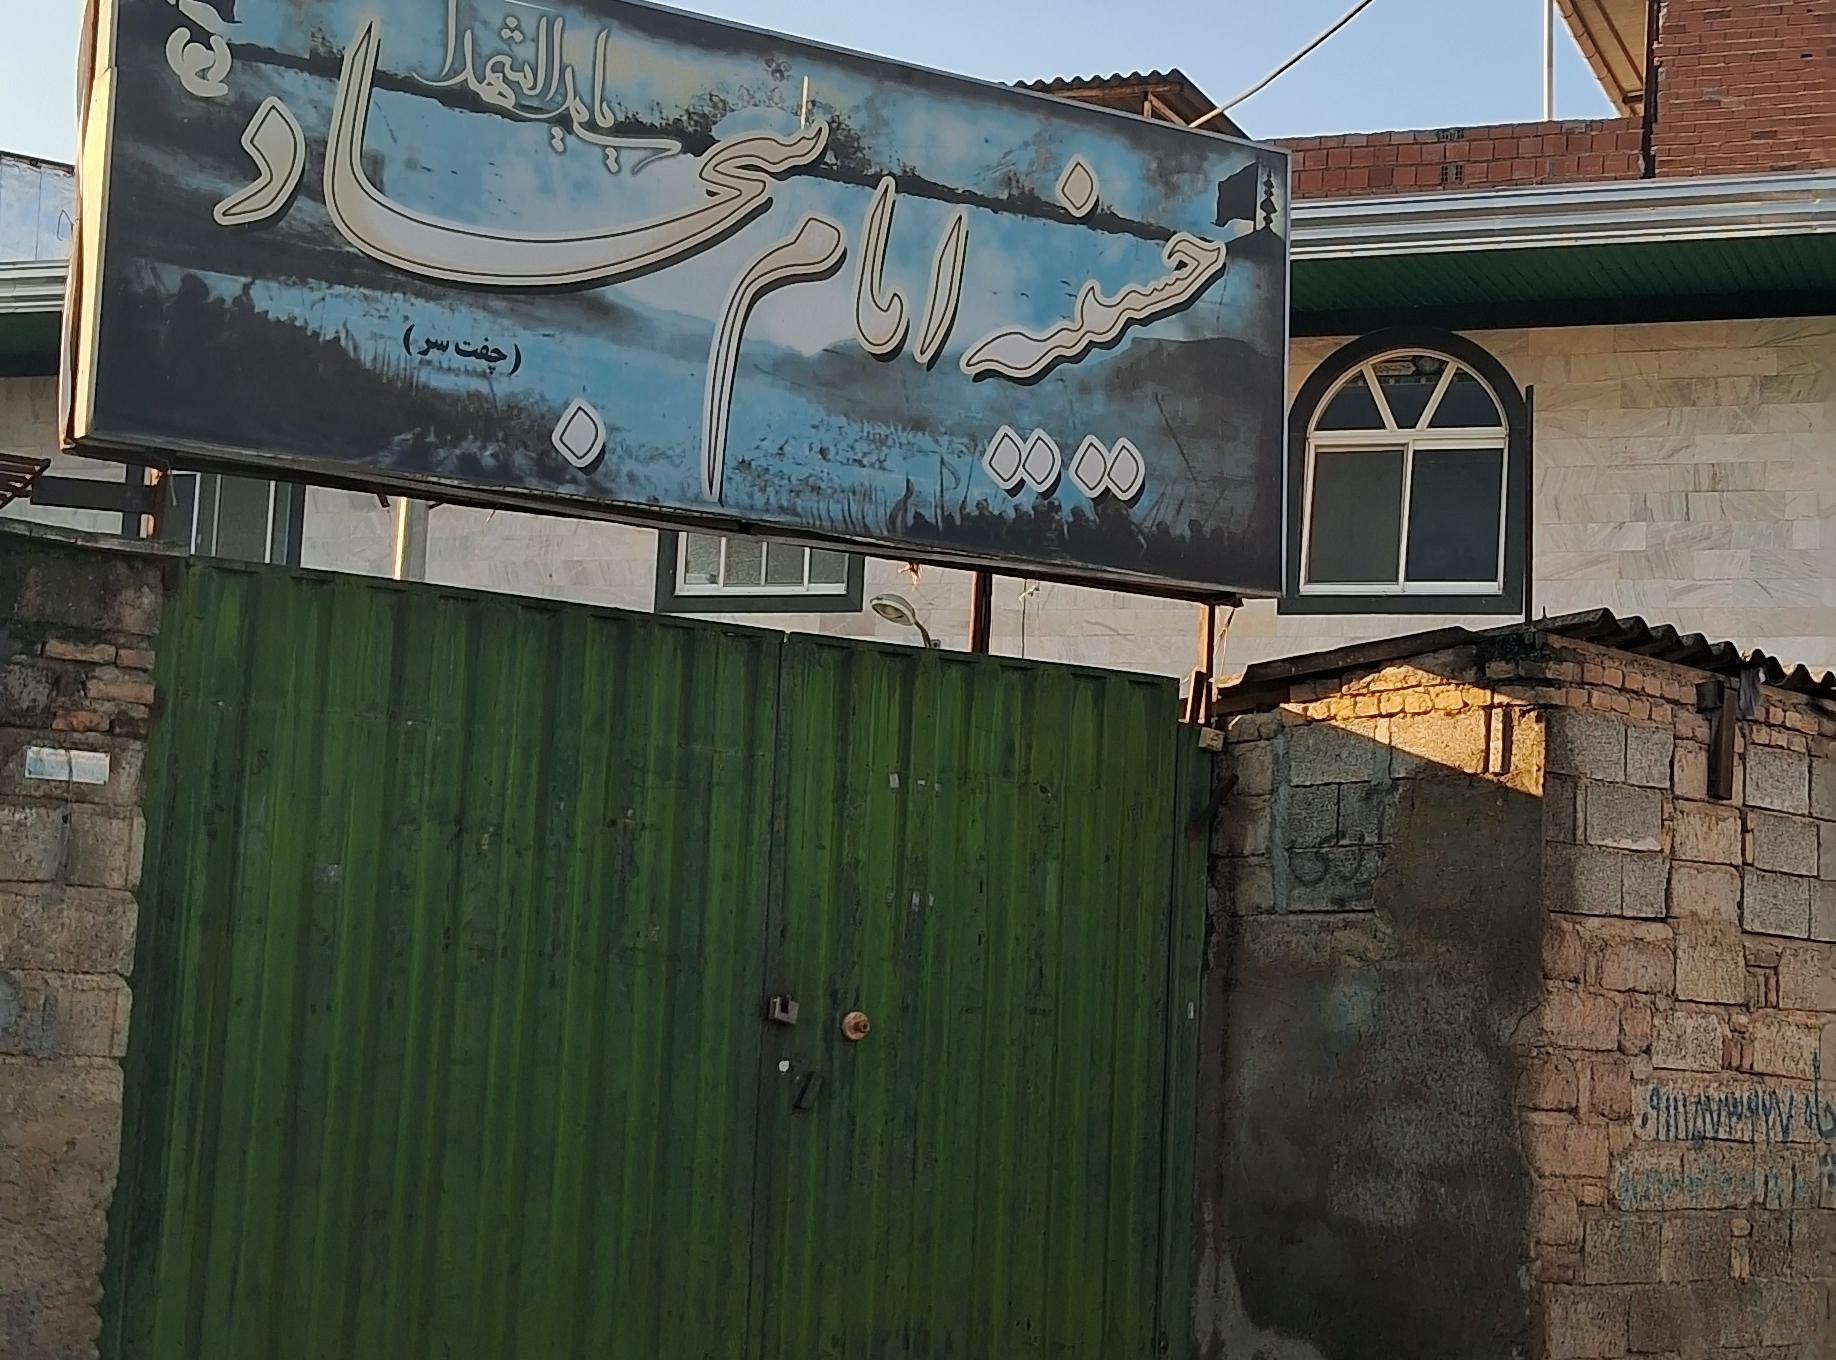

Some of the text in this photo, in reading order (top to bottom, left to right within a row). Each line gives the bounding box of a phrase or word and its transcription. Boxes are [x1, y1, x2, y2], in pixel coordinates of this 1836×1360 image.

[211, 14, 832, 470] سجاد
[702, 174, 966, 506] امام
[960, 152, 1228, 502] حسینیه
